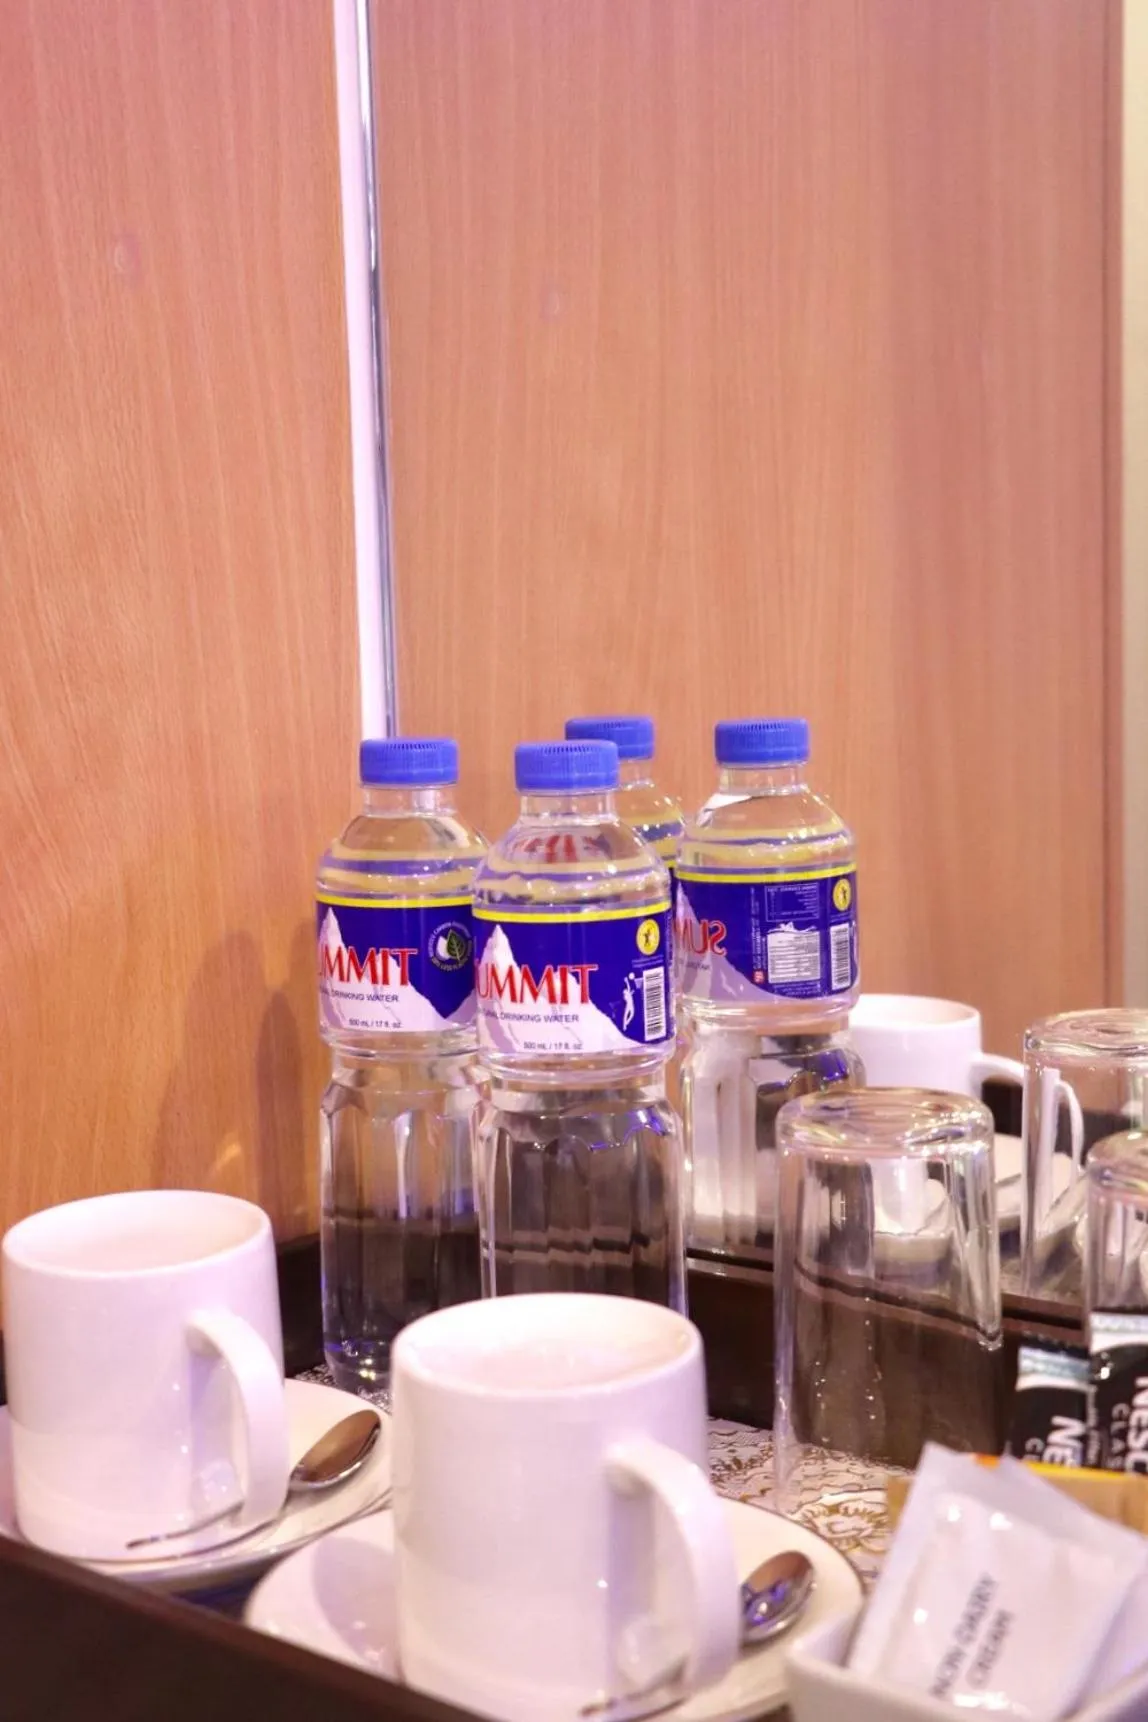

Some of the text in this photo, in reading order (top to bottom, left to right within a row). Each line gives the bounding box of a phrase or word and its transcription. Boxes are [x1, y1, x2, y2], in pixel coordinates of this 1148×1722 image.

[320, 944, 418, 986] MMIT
[474, 958, 599, 1005] UMMIT
[331, 989, 364, 1001] DRINKING
[365, 993, 399, 1003] WATER
[500, 1011, 541, 1022] DRINKING
[543, 1013, 579, 1023] WATER
